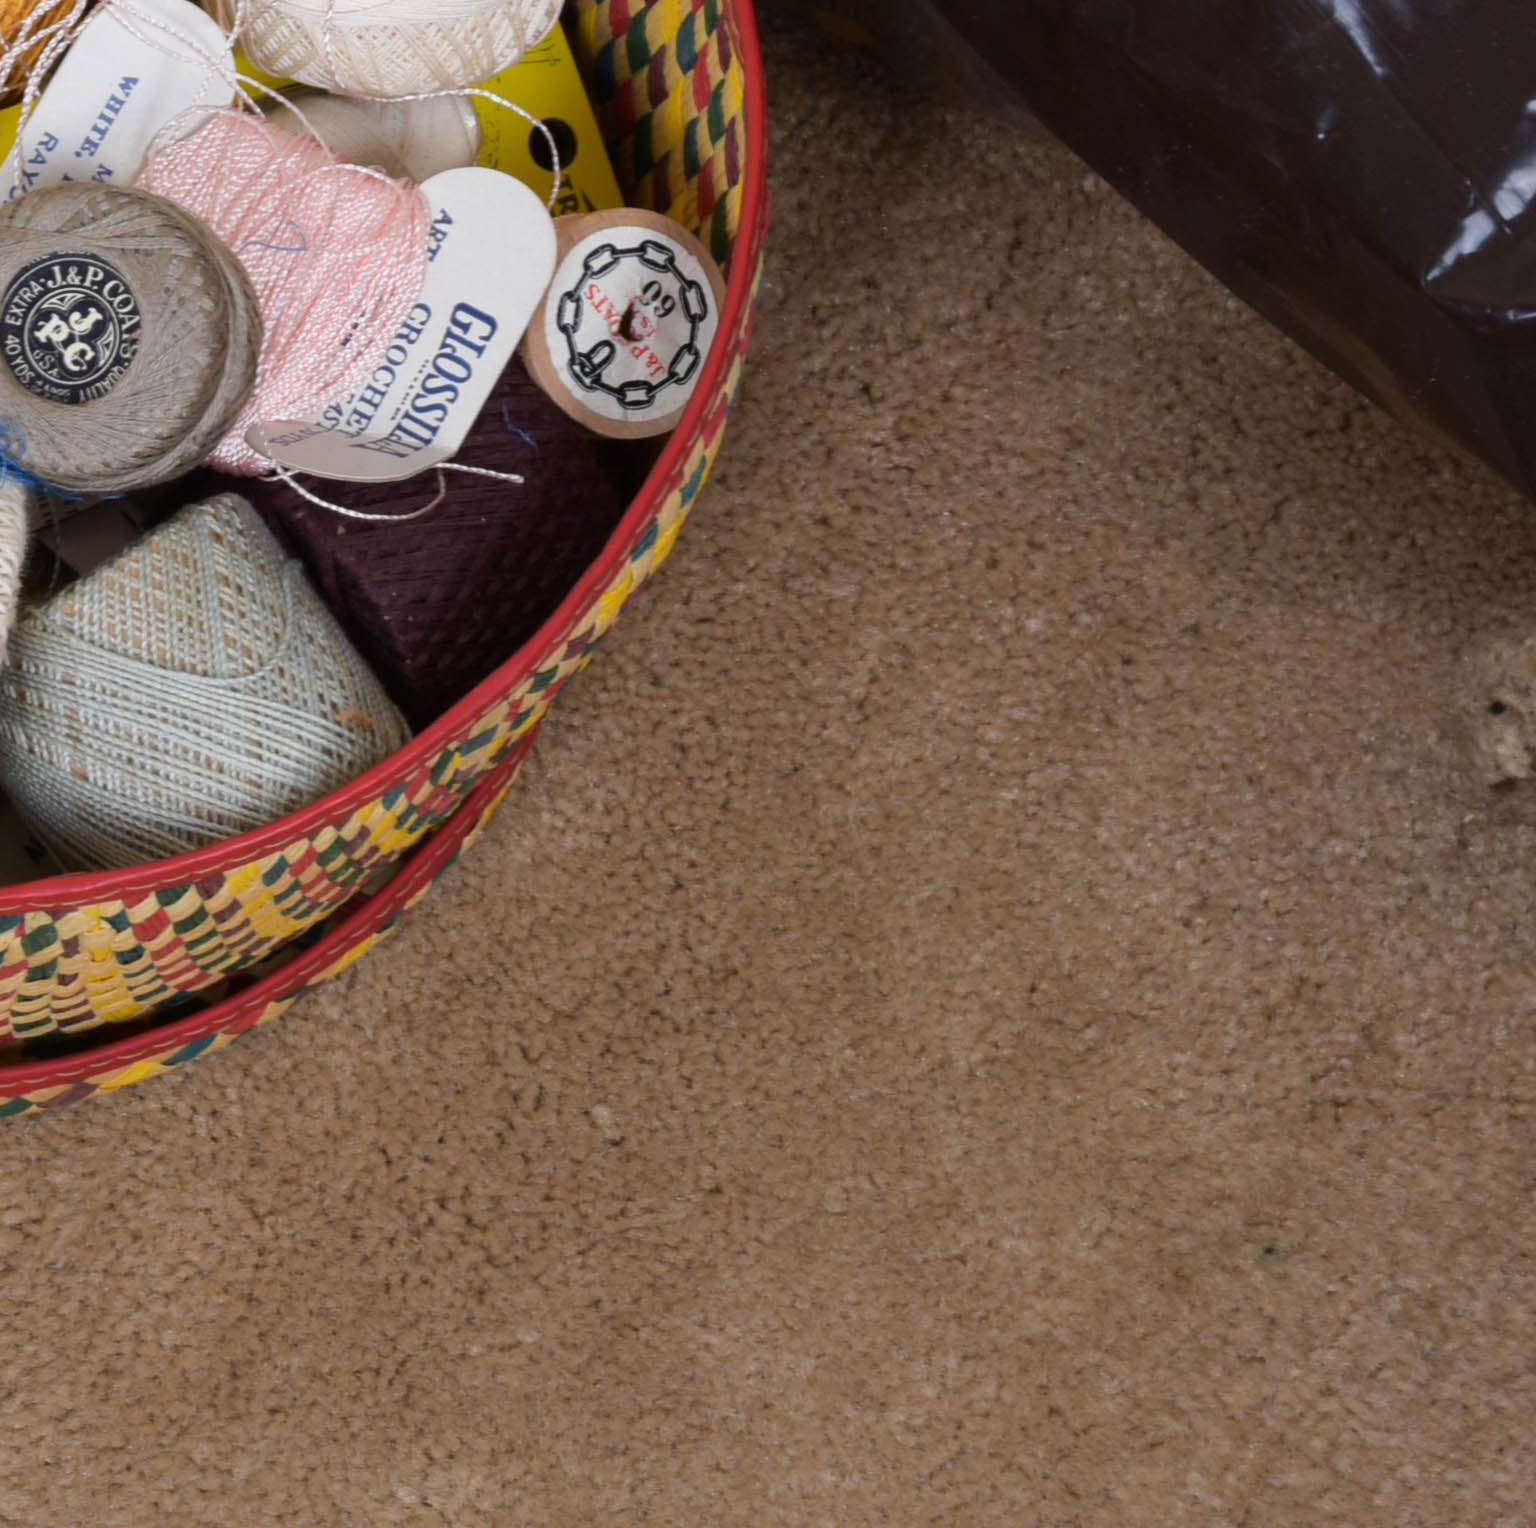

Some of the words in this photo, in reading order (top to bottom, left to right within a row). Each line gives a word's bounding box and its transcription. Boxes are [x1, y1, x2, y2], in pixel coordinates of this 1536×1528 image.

[427, 207, 454, 262] ART
[4, 279, 45, 326] EXTRA
[638, 279, 676, 319] 60
[337, 302, 433, 439] CROCHET
[349, 301, 499, 459] GLOSSILLA
